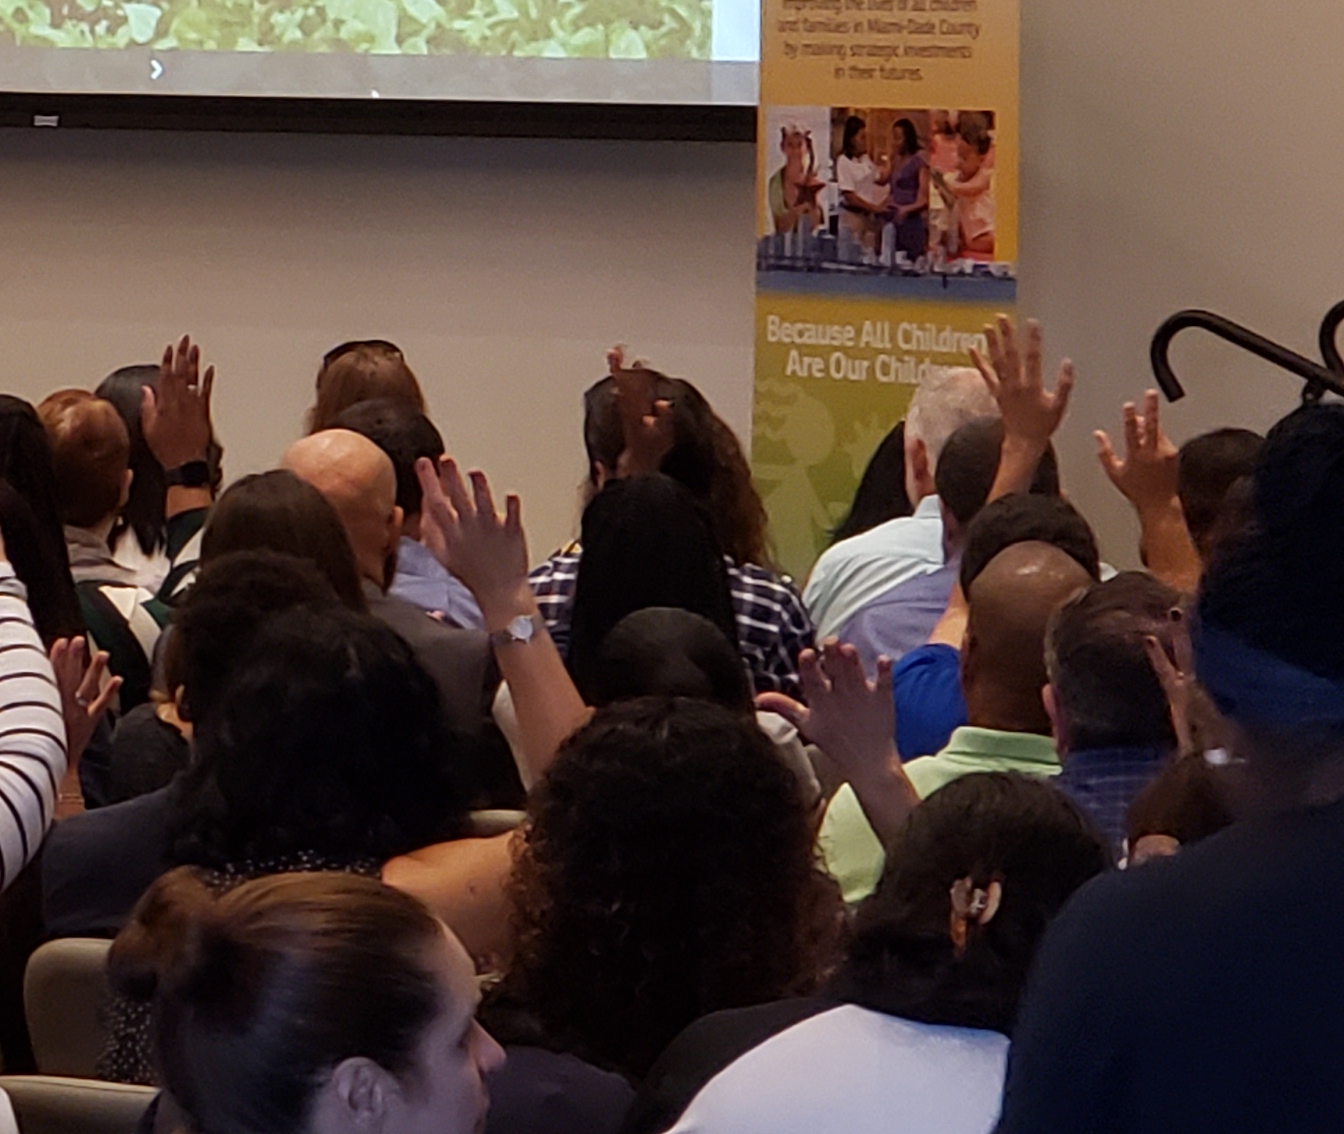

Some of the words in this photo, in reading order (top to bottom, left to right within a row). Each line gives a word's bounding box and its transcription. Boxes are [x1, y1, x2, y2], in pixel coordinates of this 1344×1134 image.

[867, 18, 937, 35] Miami-Dade
[939, 18, 981, 40] County
[766, 315, 855, 346] Because
[859, 320, 892, 349] All
[897, 322, 990, 357] Children
[785, 349, 825, 379] Are
[829, 351, 871, 381] Our
